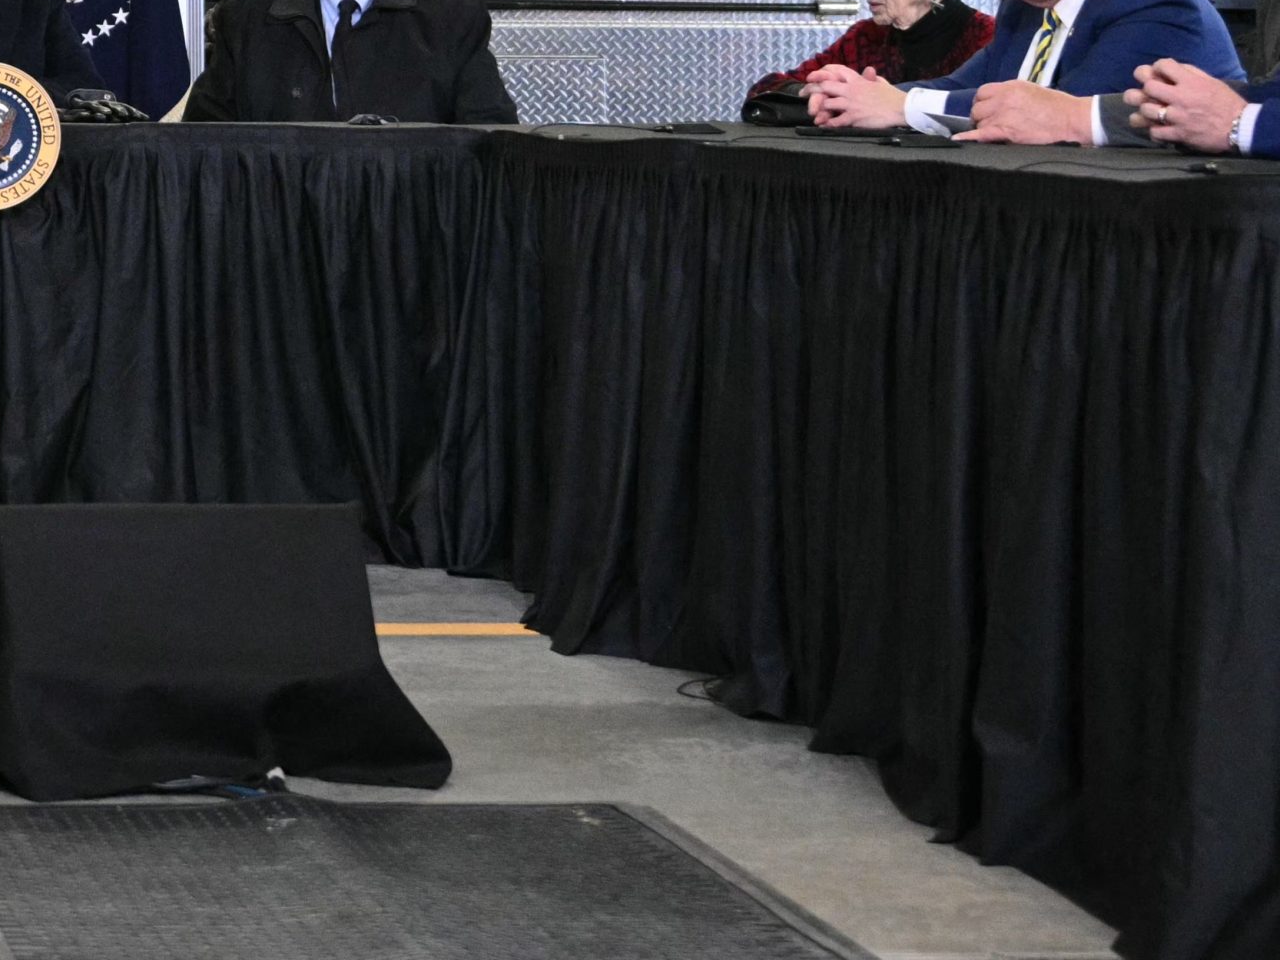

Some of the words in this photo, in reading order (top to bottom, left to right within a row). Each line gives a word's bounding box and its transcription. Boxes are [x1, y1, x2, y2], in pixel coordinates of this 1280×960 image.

[4, 73, 22, 87] THE
[25, 85, 56, 146] UNITED
[0, 159, 50, 204] STATES
